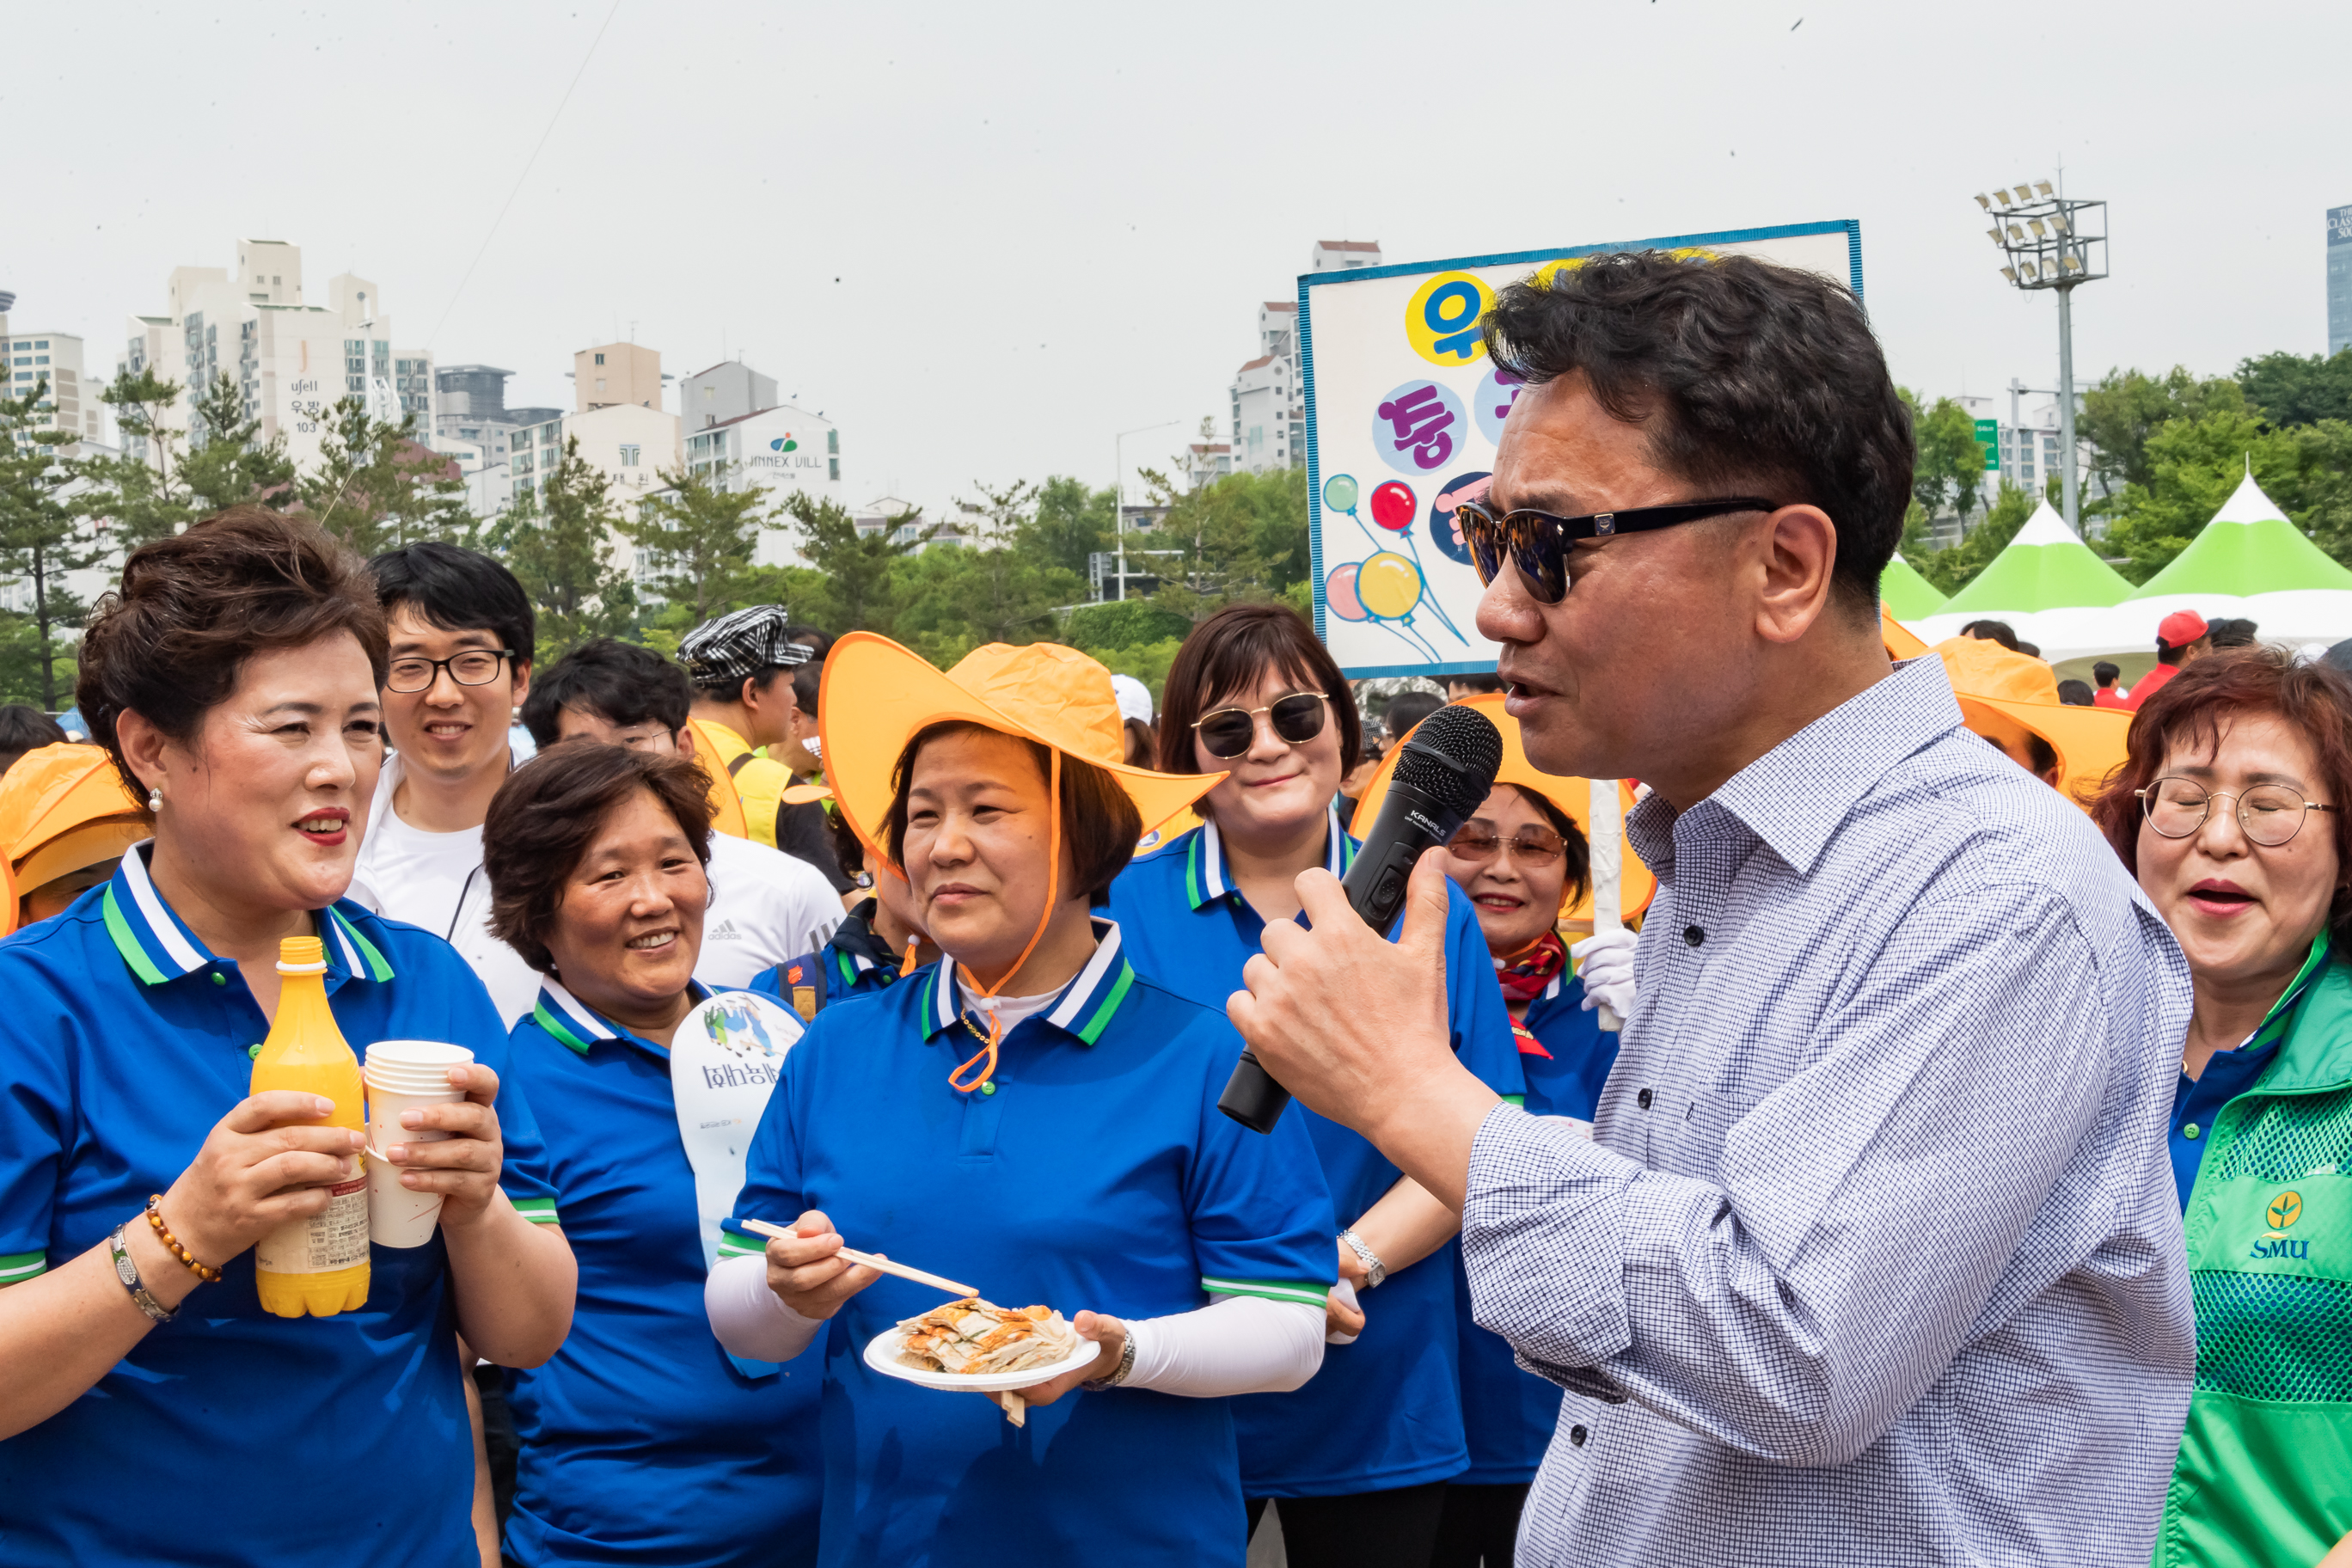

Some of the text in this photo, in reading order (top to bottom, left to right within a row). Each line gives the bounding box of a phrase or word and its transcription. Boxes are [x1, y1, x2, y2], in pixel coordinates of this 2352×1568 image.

[296, 422, 316, 432] 103
[1410, 810, 1446, 836] KANALS
[708, 931, 742, 940] adidas
[2250, 1239, 2310, 1260] SMU
